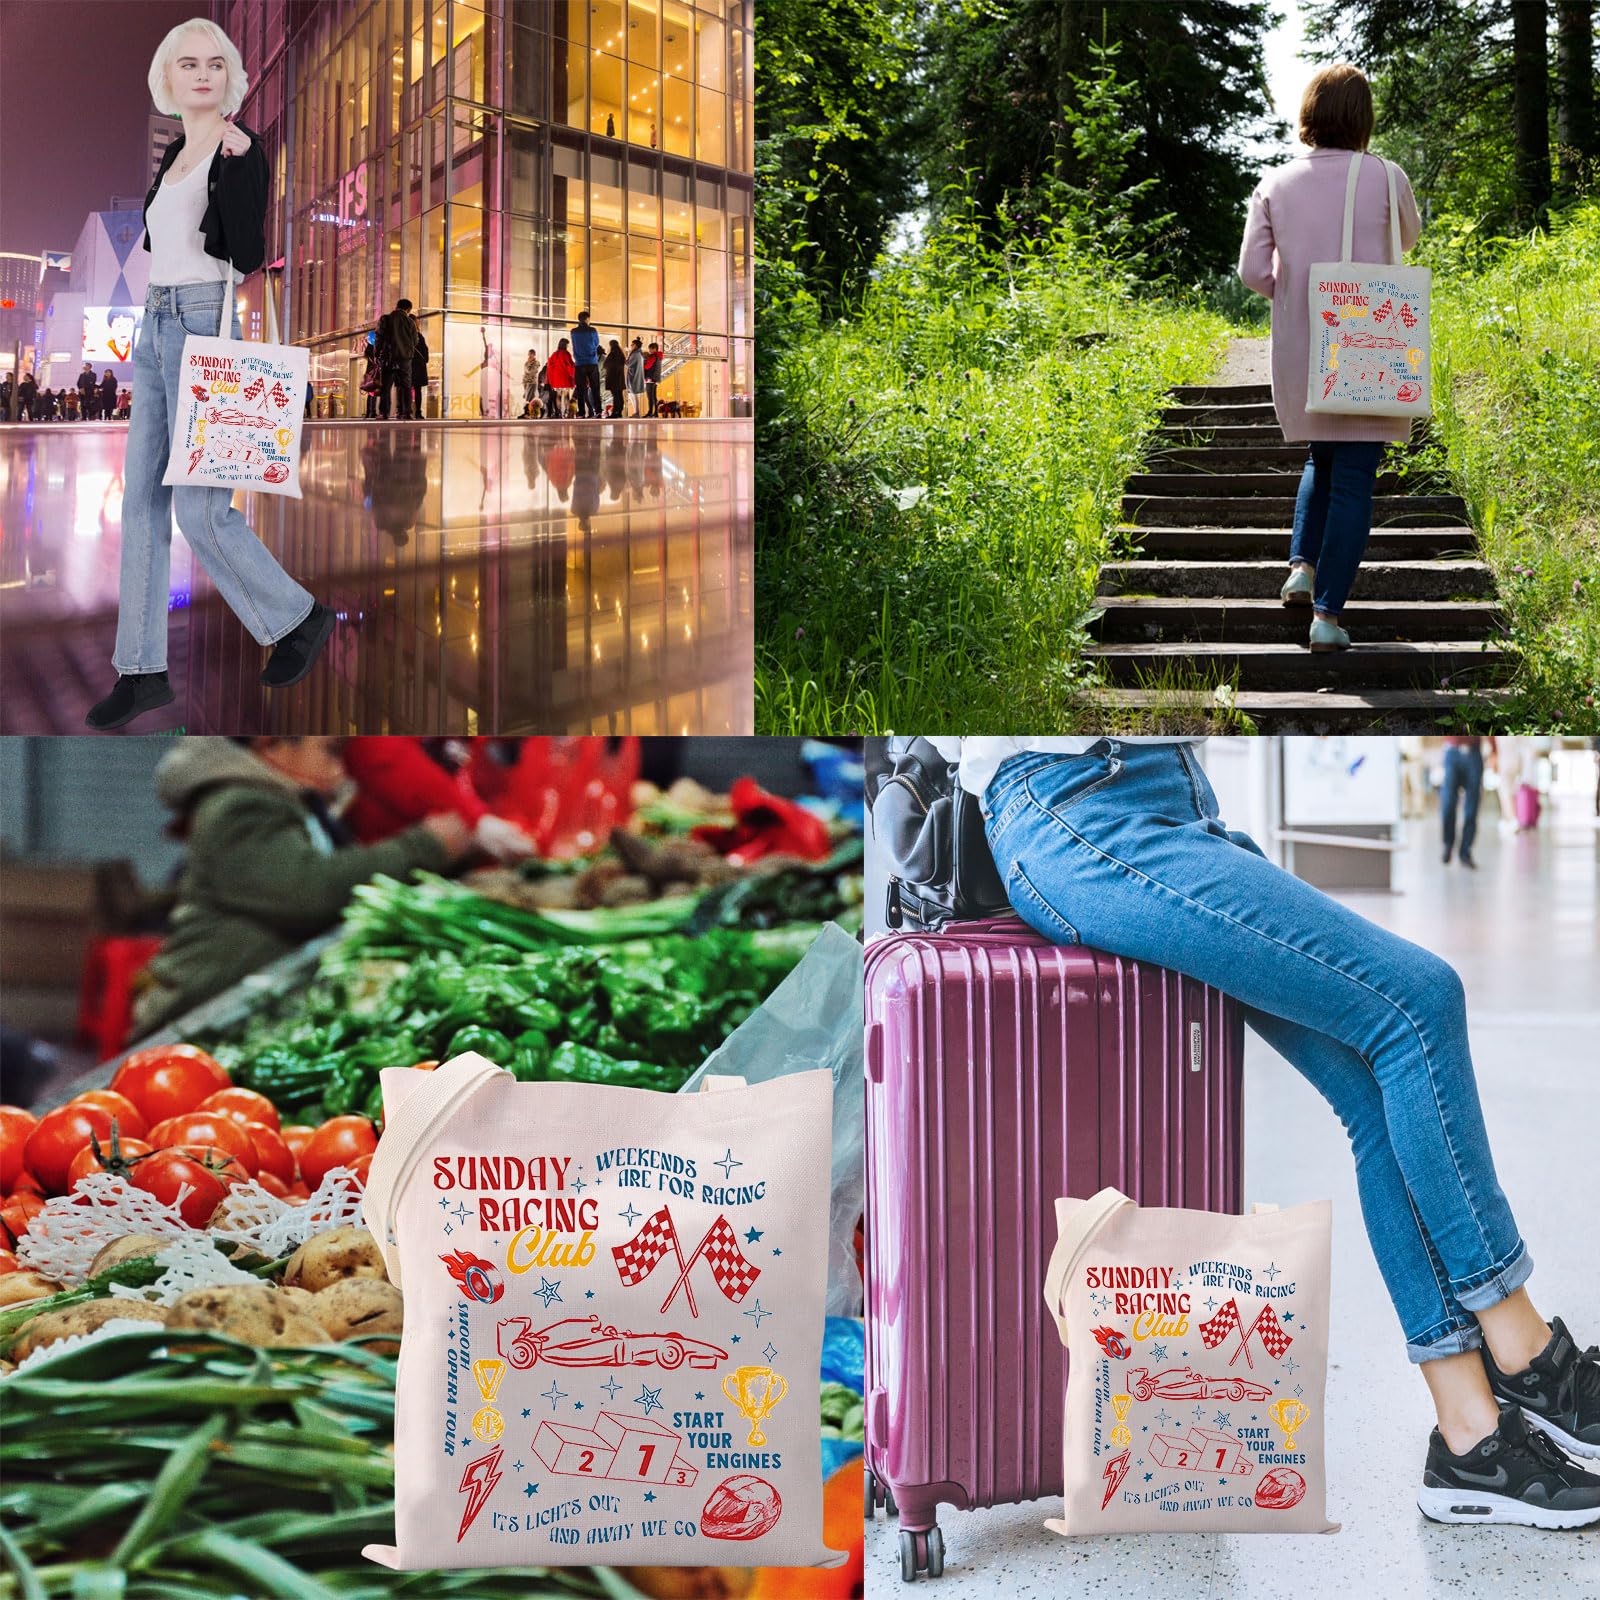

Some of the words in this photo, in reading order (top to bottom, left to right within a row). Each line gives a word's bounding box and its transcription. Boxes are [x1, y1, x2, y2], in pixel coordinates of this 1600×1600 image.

[339, 163, 367, 229] IFS
[1319, 282, 1361, 294] SUNDAY
[190, 355, 234, 370] SUNDAY
[203, 369, 241, 383] RACING
[210, 380, 239, 395] Club
[227, 450, 233, 458] 2
[245, 450, 252, 461] 1
[432, 1156, 571, 1191] SUNDAY
[596, 1148, 698, 1179] WEEKENDS
[618, 1169, 651, 1188] ARE
[659, 1173, 695, 1199] FOR
[702, 1181, 767, 1206] RACING
[479, 1197, 599, 1233] RACING
[506, 1224, 597, 1274] Club
[1086, 1266, 1174, 1289] SUNDAY
[1189, 1261, 1253, 1281] WEEKENDS
[1203, 1275, 1224, 1288] ARE
[1228, 1279, 1251, 1294] FOR
[1255, 1282, 1296, 1298] RACING
[1115, 1293, 1192, 1316] RACING
[457, 1301, 470, 1371] SMOOTH
[1132, 1310, 1190, 1342] Club
[447, 1348, 459, 1405] OPERA
[673, 1411, 725, 1429] START
[444, 1410, 457, 1457] TOUR
[687, 1432, 733, 1449] YOUR
[1093, 1427, 1102, 1457] TOUR
[1237, 1428, 1270, 1439] START
[1246, 1441, 1274, 1451] YOUR
[578, 1450, 595, 1473] 2
[638, 1444, 656, 1477] 1
[676, 1471, 687, 1484] 3
[706, 1453, 783, 1470] ENGINES
[1177, 1452, 1188, 1467] 2
[1215, 1448, 1227, 1469] 1
[1240, 1465, 1246, 1474] 3
[1258, 1454, 1306, 1464] ENGINES
[1145, 1483, 1180, 1502] LIGHTS
[1184, 1480, 1205, 1492] OUT
[1217, 1497, 1234, 1507] WE
[1238, 1496, 1253, 1507] GO
[526, 1498, 582, 1531] LIGHTS
[588, 1494, 621, 1514] OUT
[549, 1526, 580, 1545] AND
[586, 1522, 634, 1545] AWAY
[641, 1520, 667, 1537] WE
[674, 1520, 697, 1537] GO
